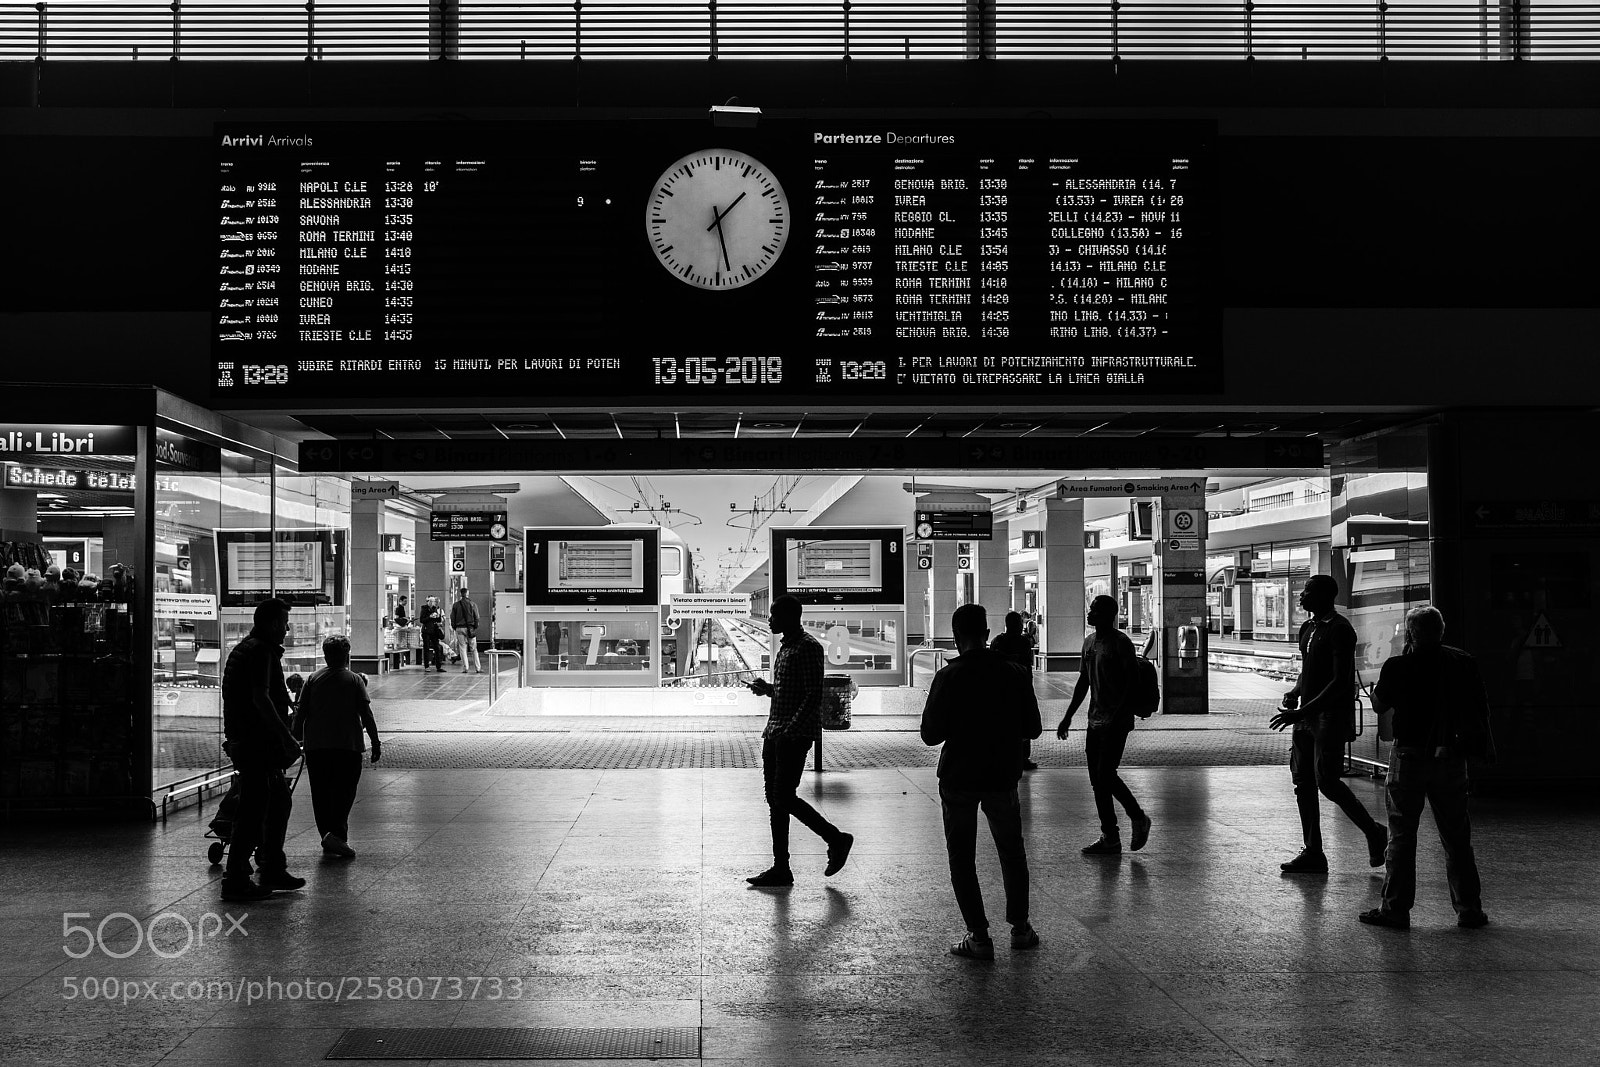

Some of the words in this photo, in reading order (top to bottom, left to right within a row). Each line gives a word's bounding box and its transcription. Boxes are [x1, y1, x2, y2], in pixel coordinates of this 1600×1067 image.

[222, 135, 262, 146] Arrivi
[268, 134, 312, 146] Arrivals
[814, 133, 881, 143] Partenze
[887, 132, 954, 145] Departures
[258, 183, 276, 191] 9912
[300, 182, 338, 192] NAPOLI
[344, 182, 367, 192] C.LE
[385, 181, 413, 192] 13:28
[424, 181, 439, 192] 10'
[895, 179, 934, 189] GENOVA
[941, 179, 968, 189] BRIG.
[980, 179, 1007, 189] 13:30
[1066, 179, 1136, 189] ALESSANDRIA
[1170, 179, 1176, 189] 7
[300, 198, 371, 208] ALESSANDRIA
[385, 198, 413, 208] 13:30
[577, 197, 584, 206] 9
[895, 196, 925, 206] IVREA
[980, 195, 1007, 206] 13:30
[1056, 195, 1094, 205] (13.53)
[1113, 195, 1144, 206] IVREA
[1170, 196, 1183, 206] 20
[257, 215, 279, 224] 10130
[300, 215, 339, 225] SAVONA
[385, 214, 413, 225] 13:35
[895, 212, 932, 222] REGGIO
[939, 212, 955, 222] CL.
[980, 212, 1007, 222] 13:35
[1084, 212, 1122, 222] (14.23)
[1171, 212, 1180, 222] 11
[300, 231, 326, 242] ROMA
[333, 231, 375, 241] TERMINI
[385, 231, 412, 241] 13:40
[895, 228, 934, 238] MODANE
[980, 228, 1007, 238] 13:45
[1052, 228, 1104, 238] COLLEGNO
[1111, 228, 1149, 238] (13.58)
[1171, 228, 1182, 238] 16
[300, 248, 337, 258] MILANO
[344, 248, 367, 258] C.LE
[385, 247, 411, 257] 14:10
[895, 245, 933, 255] MILANO
[940, 245, 962, 255] C.LE
[981, 245, 1007, 255] 13:54
[1079, 245, 1129, 255] CHIVASSO
[300, 264, 339, 274] MODANE
[385, 264, 411, 274] 14:15
[895, 261, 938, 271] TRIESTE
[945, 261, 967, 271] C.LE
[981, 261, 1008, 271] 14:05
[1100, 261, 1137, 271] MILANO
[1144, 261, 1166, 271] C.LE
[300, 281, 339, 291] GENOVA
[347, 281, 374, 291] BRIG.
[386, 280, 413, 291] 14:30
[853, 278, 872, 286] 9939
[896, 278, 922, 288] ROMA
[929, 278, 971, 288] TERMINI
[981, 278, 1007, 288] 14:10
[1061, 278, 1097, 288] (14.18)
[1116, 278, 1154, 288] MILANO
[300, 297, 333, 307] CUNEO
[385, 297, 413, 307] 14:35
[896, 294, 922, 304] ROMA
[929, 294, 971, 304] TERMINI
[982, 294, 1009, 304] 14:20
[1074, 294, 1112, 304] (14.28)
[299, 314, 330, 325] IVREA
[385, 314, 412, 324] 14:35
[982, 311, 1009, 321] 14:25
[1075, 311, 1102, 321] LING.
[1108, 311, 1146, 321] (14.33)
[299, 330, 342, 341] TRIESTE
[349, 330, 371, 340] C.LE
[385, 330, 412, 340] 14:55
[982, 327, 1009, 337] 14:30
[1084, 327, 1111, 337] LING.
[1118, 327, 1156, 337] (14.37)
[340, 360, 382, 370] RITARDI
[389, 360, 421, 370] ENTRO
[435, 359, 446, 369] 15
[498, 359, 517, 369] PER
[525, 359, 563, 369] LAVORI
[569, 359, 580, 369] DI
[587, 358, 620, 368] POTEN
[939, 357, 977, 367] LAVORI
[984, 357, 995, 367] DI
[1001, 357, 1084, 367] POTENZIAMENTO
[242, 365, 288, 384] 13:28
[652, 357, 782, 384] 13-05-2018
[840, 361, 886, 379] 13:28
[1049, 373, 1062, 383] LA
[1107, 373, 1144, 383] GIALLA
[10, 467, 77, 487] Schede
[1090, 484, 1123, 492] Fumatori
[1136, 484, 1169, 493] Smoking
[497, 514, 502, 522] 7
[920, 513, 926, 521] 8
[533, 542, 540, 554] 7
[889, 541, 897, 553] 8
[72, 551, 80, 562] 6
[456, 561, 462, 569] 6
[581, 626, 602, 666] 7
[827, 625, 850, 665] 8
